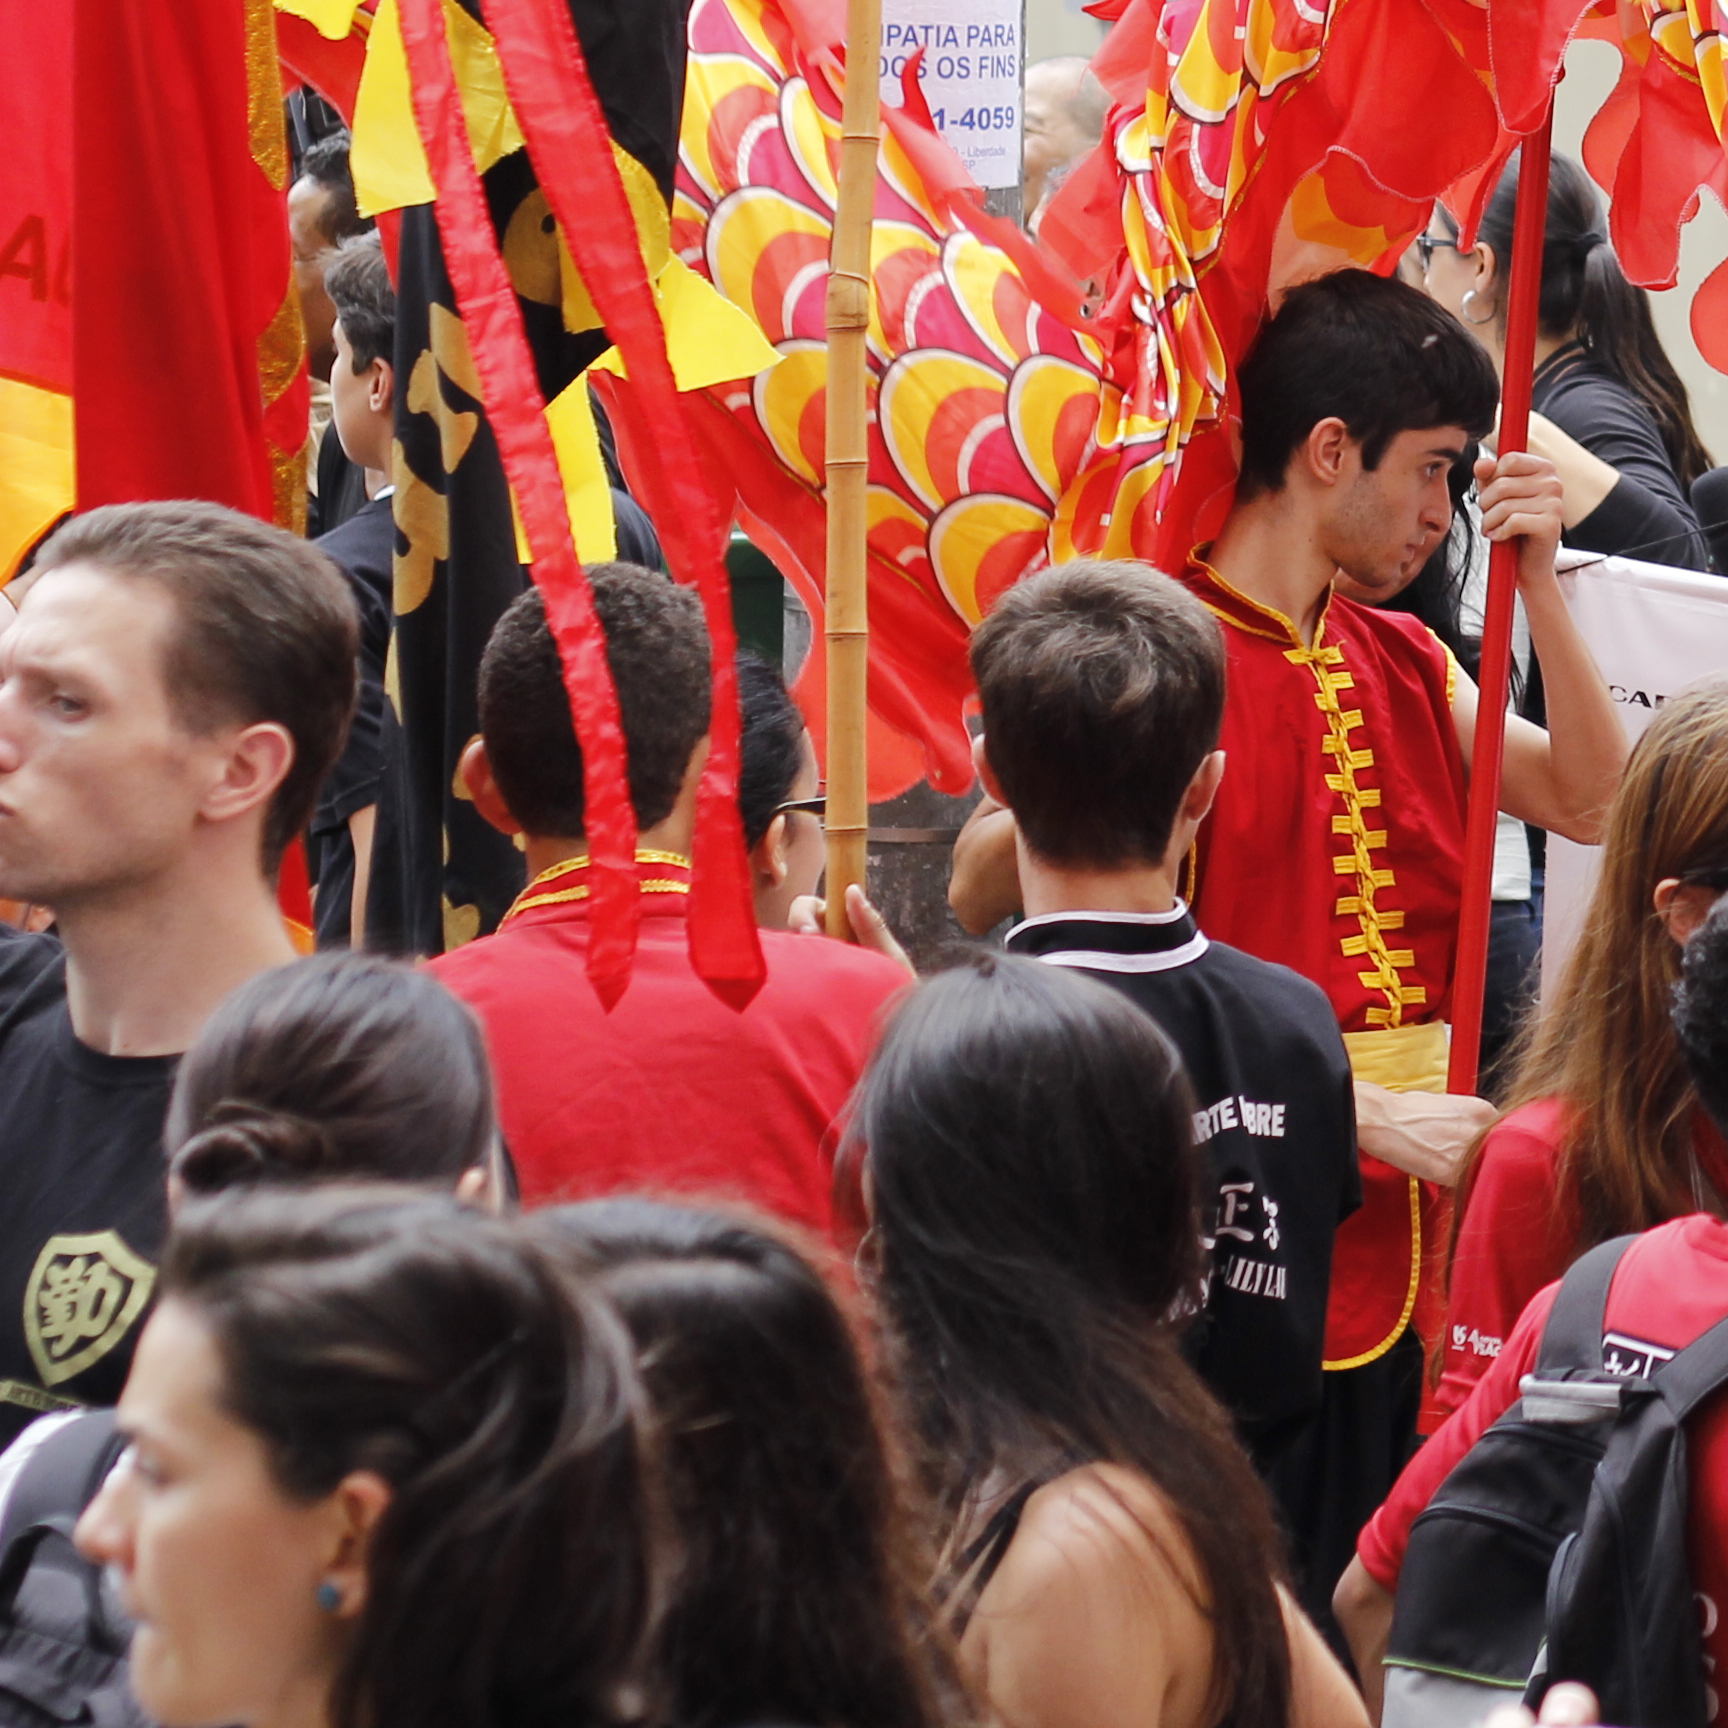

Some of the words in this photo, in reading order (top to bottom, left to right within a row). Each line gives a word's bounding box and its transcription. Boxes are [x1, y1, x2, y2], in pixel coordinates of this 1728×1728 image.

[881, 24, 959, 49] PATIA
[966, 23, 1016, 48] PARA
[936, 56, 971, 80] OS
[978, 54, 1015, 79] FINS
[931, 105, 1015, 131] 1-4059
[1191, 1096, 1239, 1146] RTE
